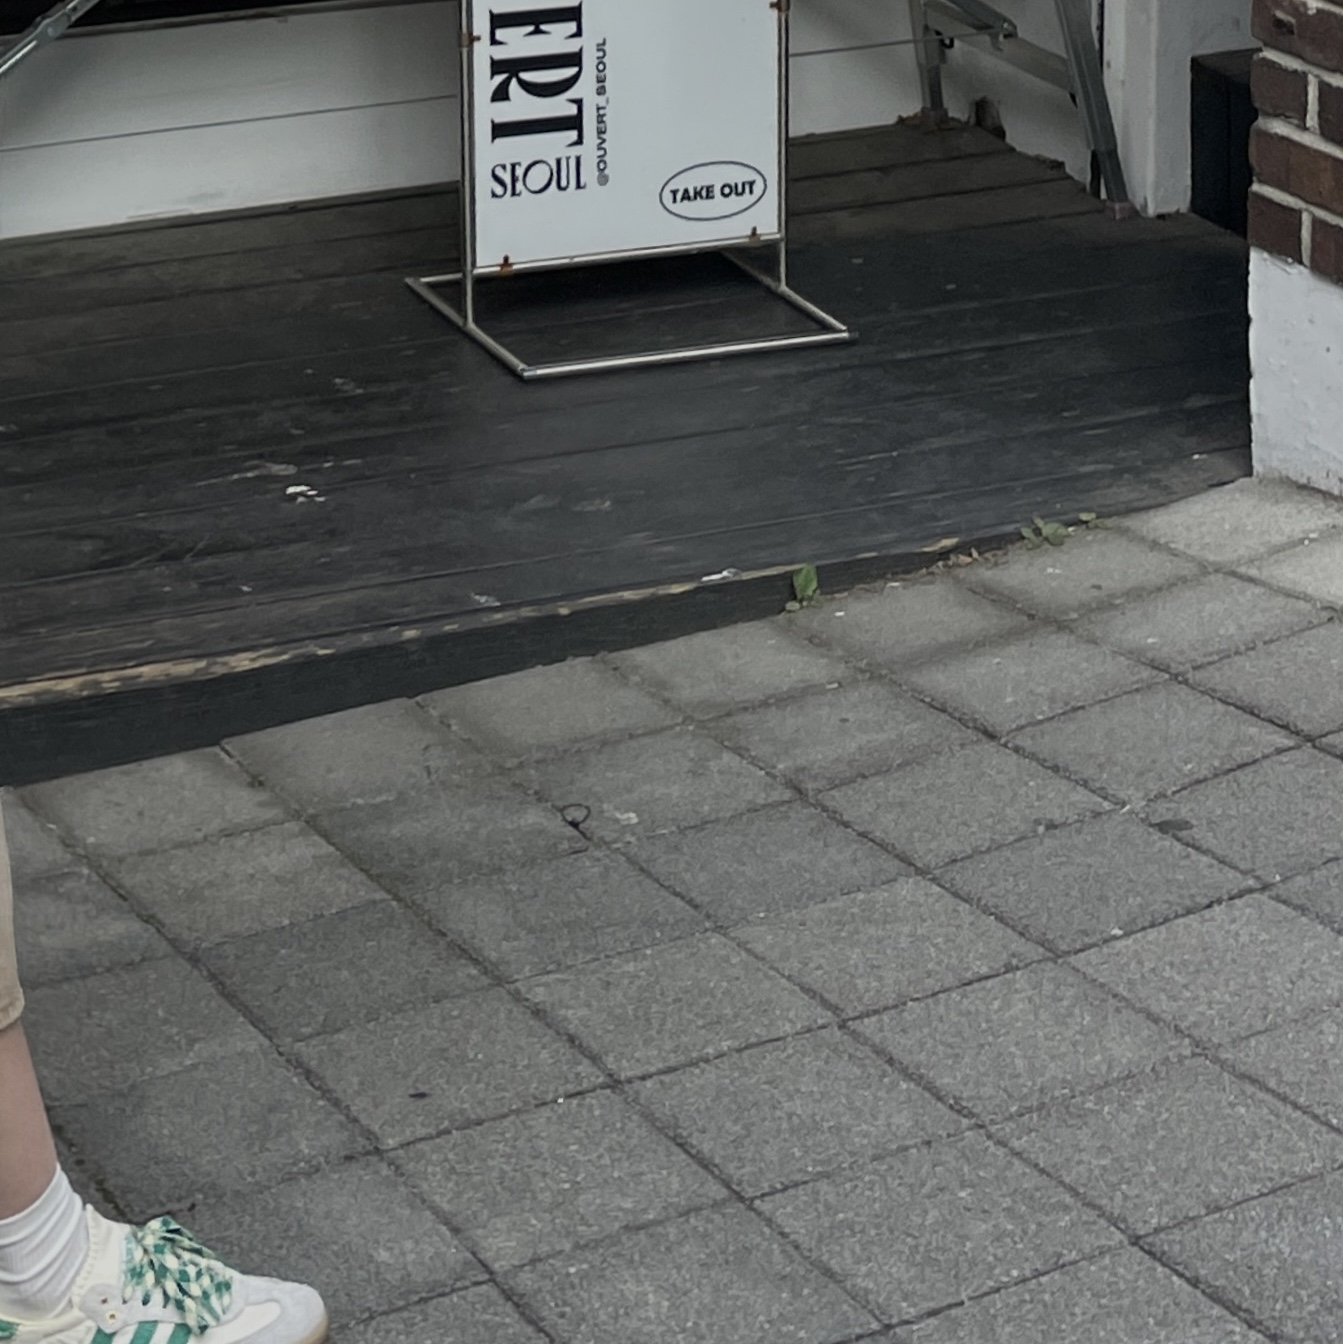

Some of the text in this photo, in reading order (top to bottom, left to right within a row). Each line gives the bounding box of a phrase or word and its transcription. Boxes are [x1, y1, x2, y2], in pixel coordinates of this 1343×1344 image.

[595, 38, 609, 187] @OUVERT_SEOUL
[490, 155, 586, 199] SEOUL
[669, 180, 756, 204] TAKE OUT
